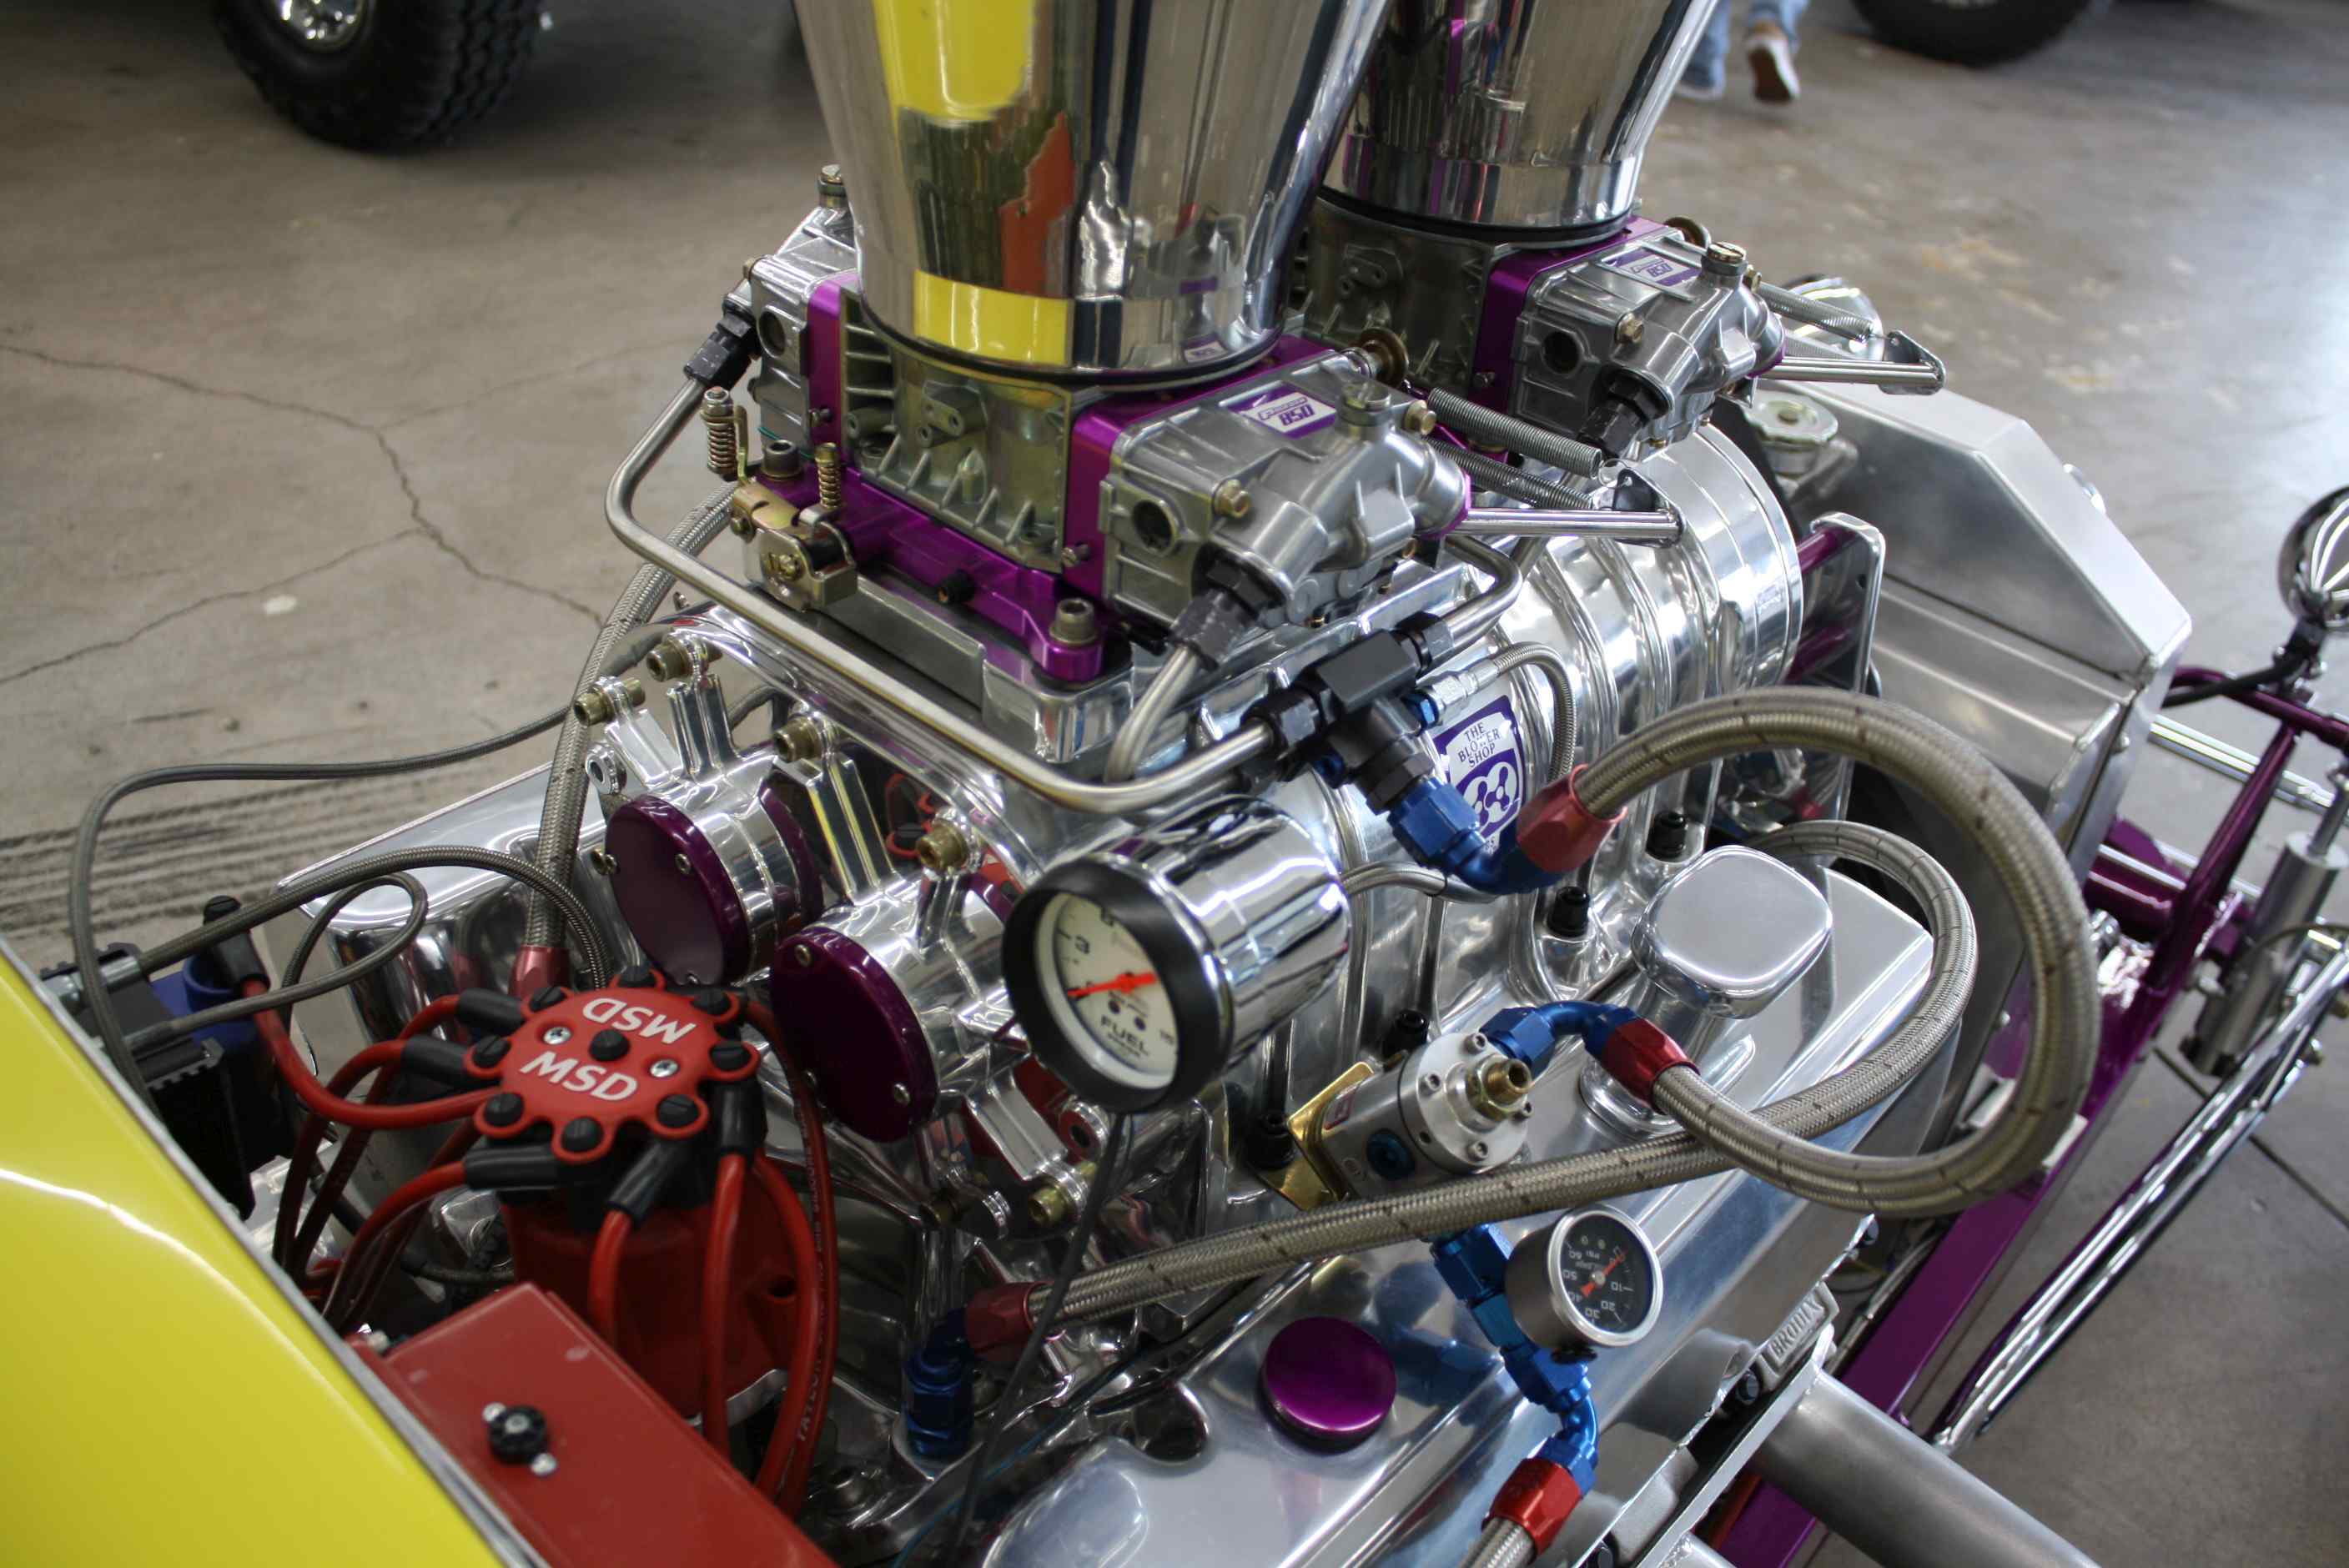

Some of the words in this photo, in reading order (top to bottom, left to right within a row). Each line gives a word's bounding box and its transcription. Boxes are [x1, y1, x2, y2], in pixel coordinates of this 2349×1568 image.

[1279, 404, 1315, 426] 850
[1464, 721, 1486, 741] THE
[1458, 728, 1500, 762] BLOER
[1468, 742, 1496, 767] SHOP
[582, 998, 697, 1044] MSD
[1100, 1014, 1149, 1057] FUEL
[520, 1051, 638, 1102] MSD
[1562, 1268, 1578, 1281] 50
[1610, 1280, 1623, 1293] 10
[1585, 1307, 1601, 1319] 30
[1600, 1299, 1616, 1312] 20
[1768, 1294, 1825, 1364] BRODIX
